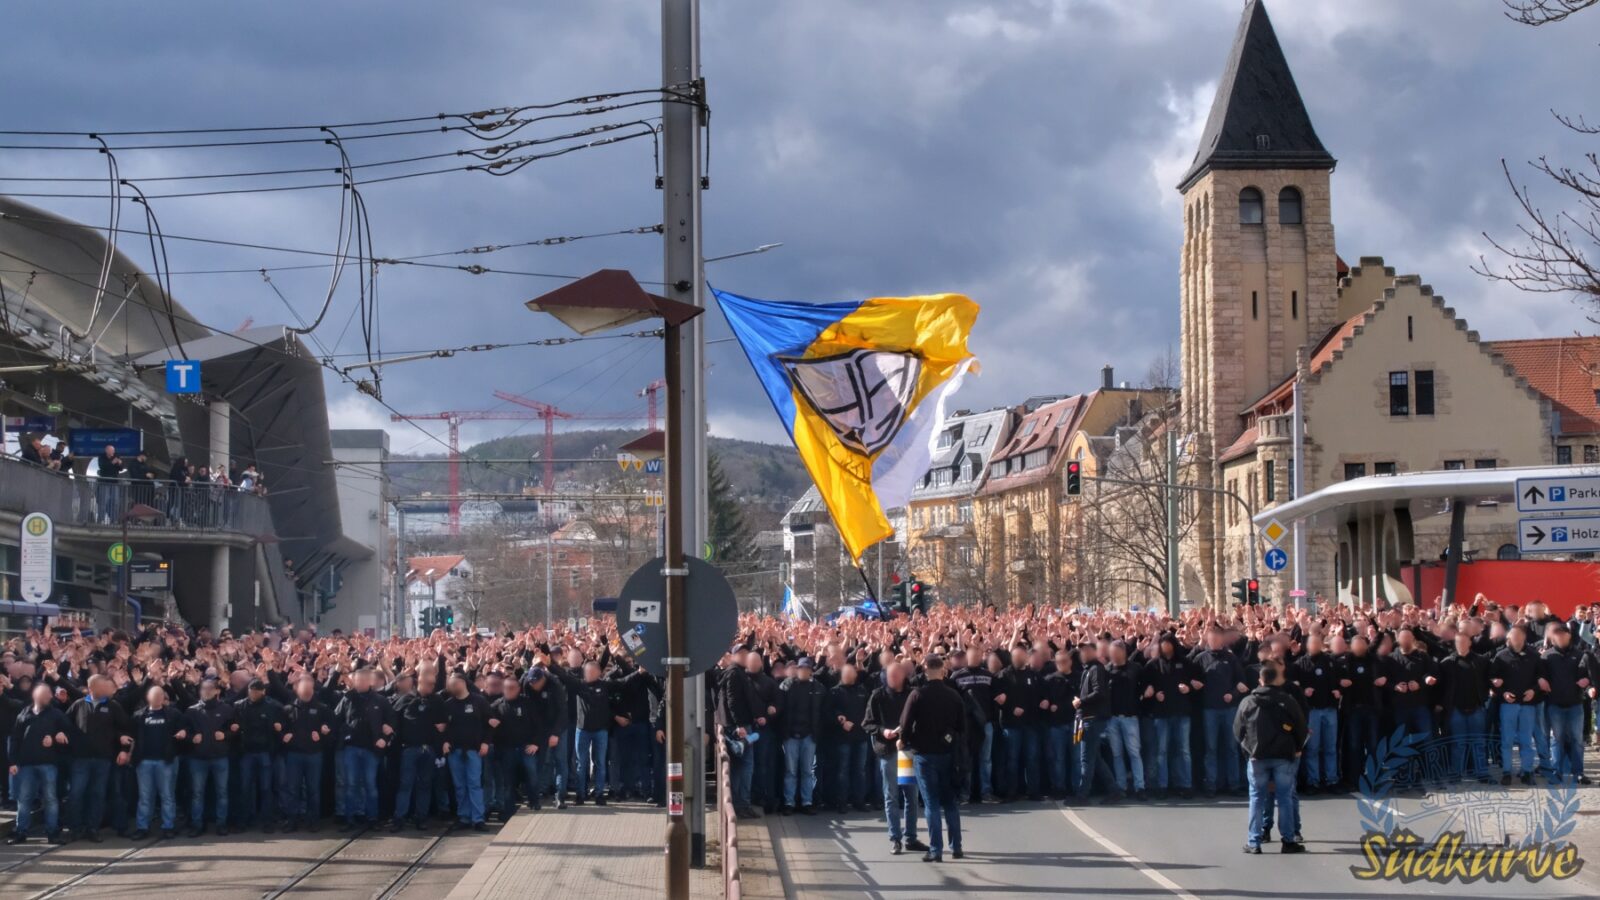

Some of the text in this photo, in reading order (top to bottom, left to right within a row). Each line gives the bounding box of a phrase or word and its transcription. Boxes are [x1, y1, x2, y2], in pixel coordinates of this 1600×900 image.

[173, 365, 192, 388] T
[647, 460, 660, 471] W
[1552, 487, 1600, 500] P Park
[32, 520, 42, 532] H
[1556, 528, 1599, 541] P Holz
